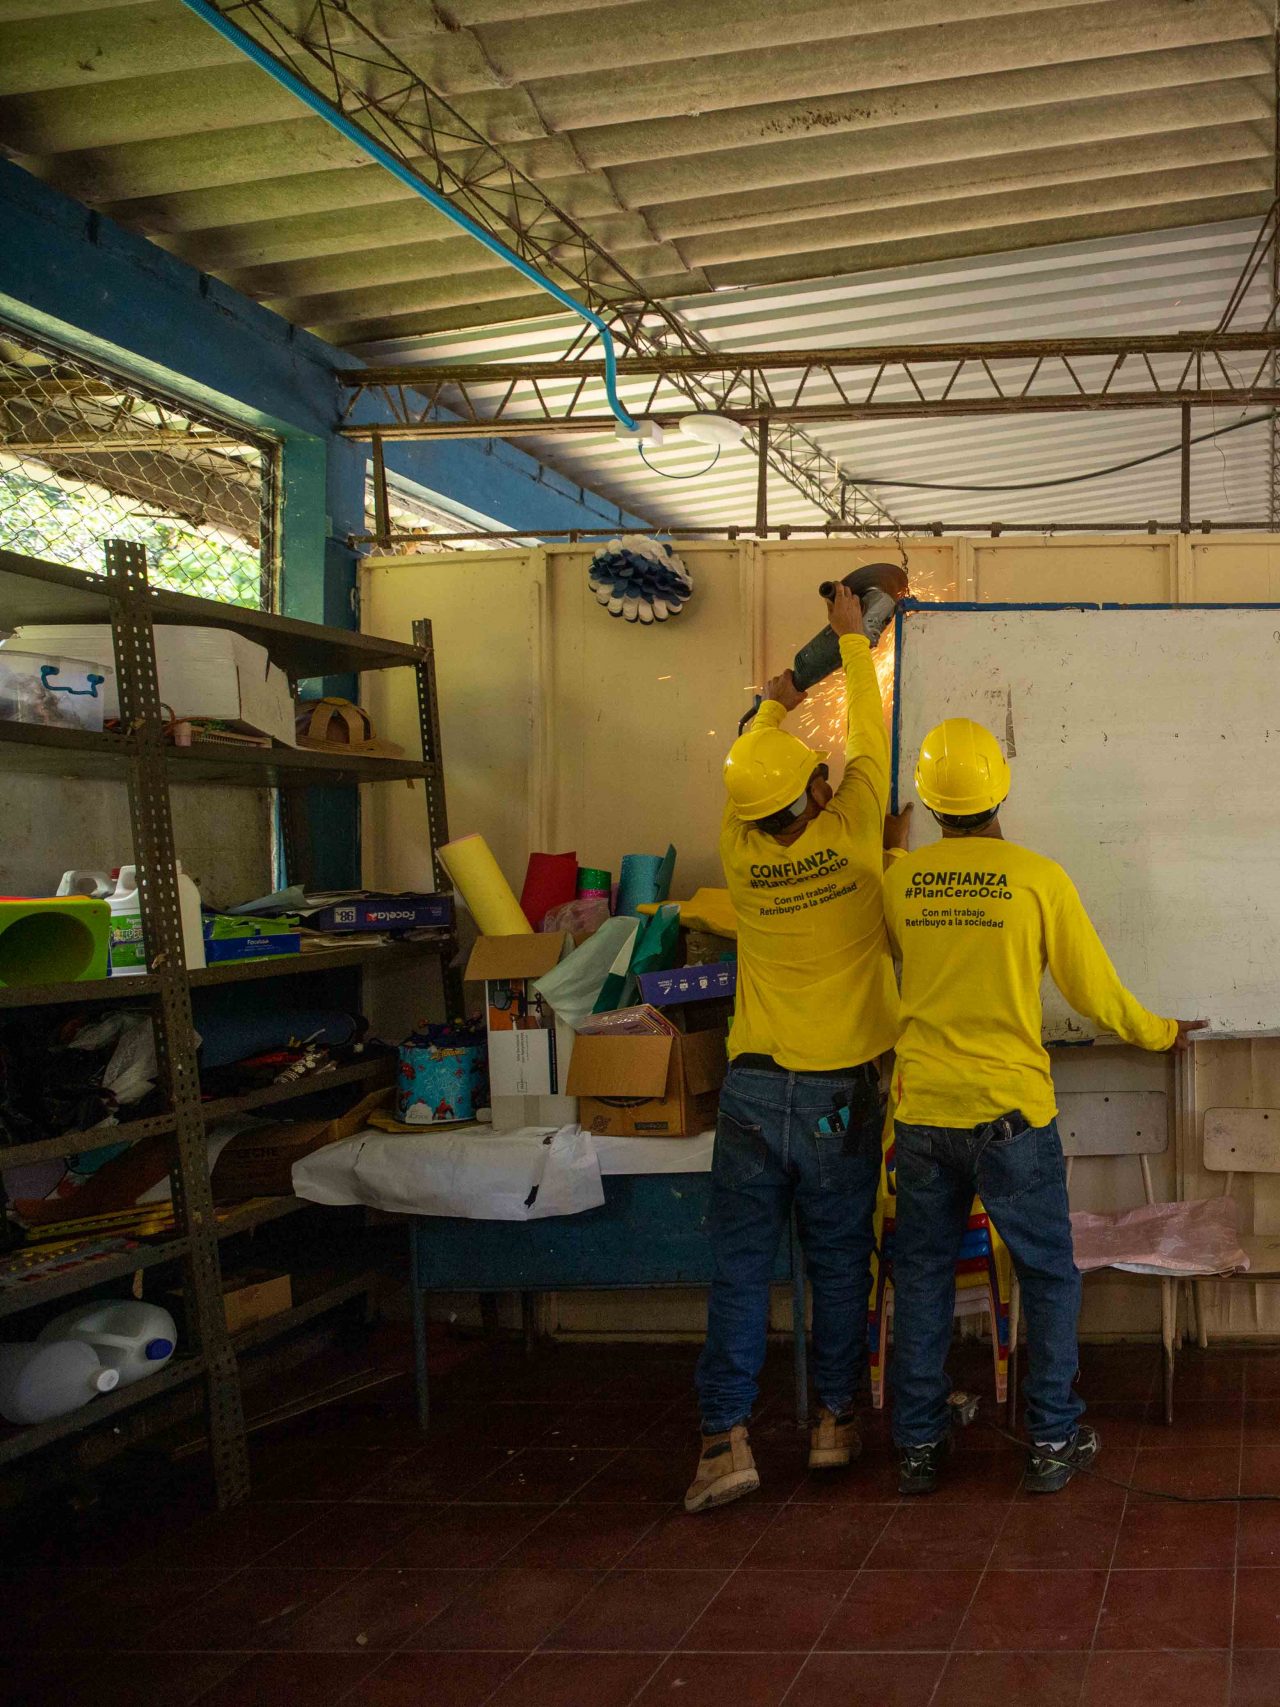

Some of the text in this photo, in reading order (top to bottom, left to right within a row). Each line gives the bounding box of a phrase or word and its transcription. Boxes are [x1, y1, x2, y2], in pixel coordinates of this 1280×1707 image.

[750, 848, 838, 878] CONFIANZA
[750, 858, 848, 889] #PlanCeroOcio
[912, 872, 1007, 887] CONFIANZA
[760, 904, 801, 916] Retribuyo
[810, 899, 818, 907] la
[819, 882, 858, 904] sociedad
[774, 883, 837, 905] Con mi trabajo
[905, 886, 1013, 900] #PlanCeroOcio
[922, 908, 985, 918] Con mi trabajo
[905, 918, 946, 928] Retribuyo
[955, 918, 962, 926] la
[964, 918, 1004, 928] sociedad
